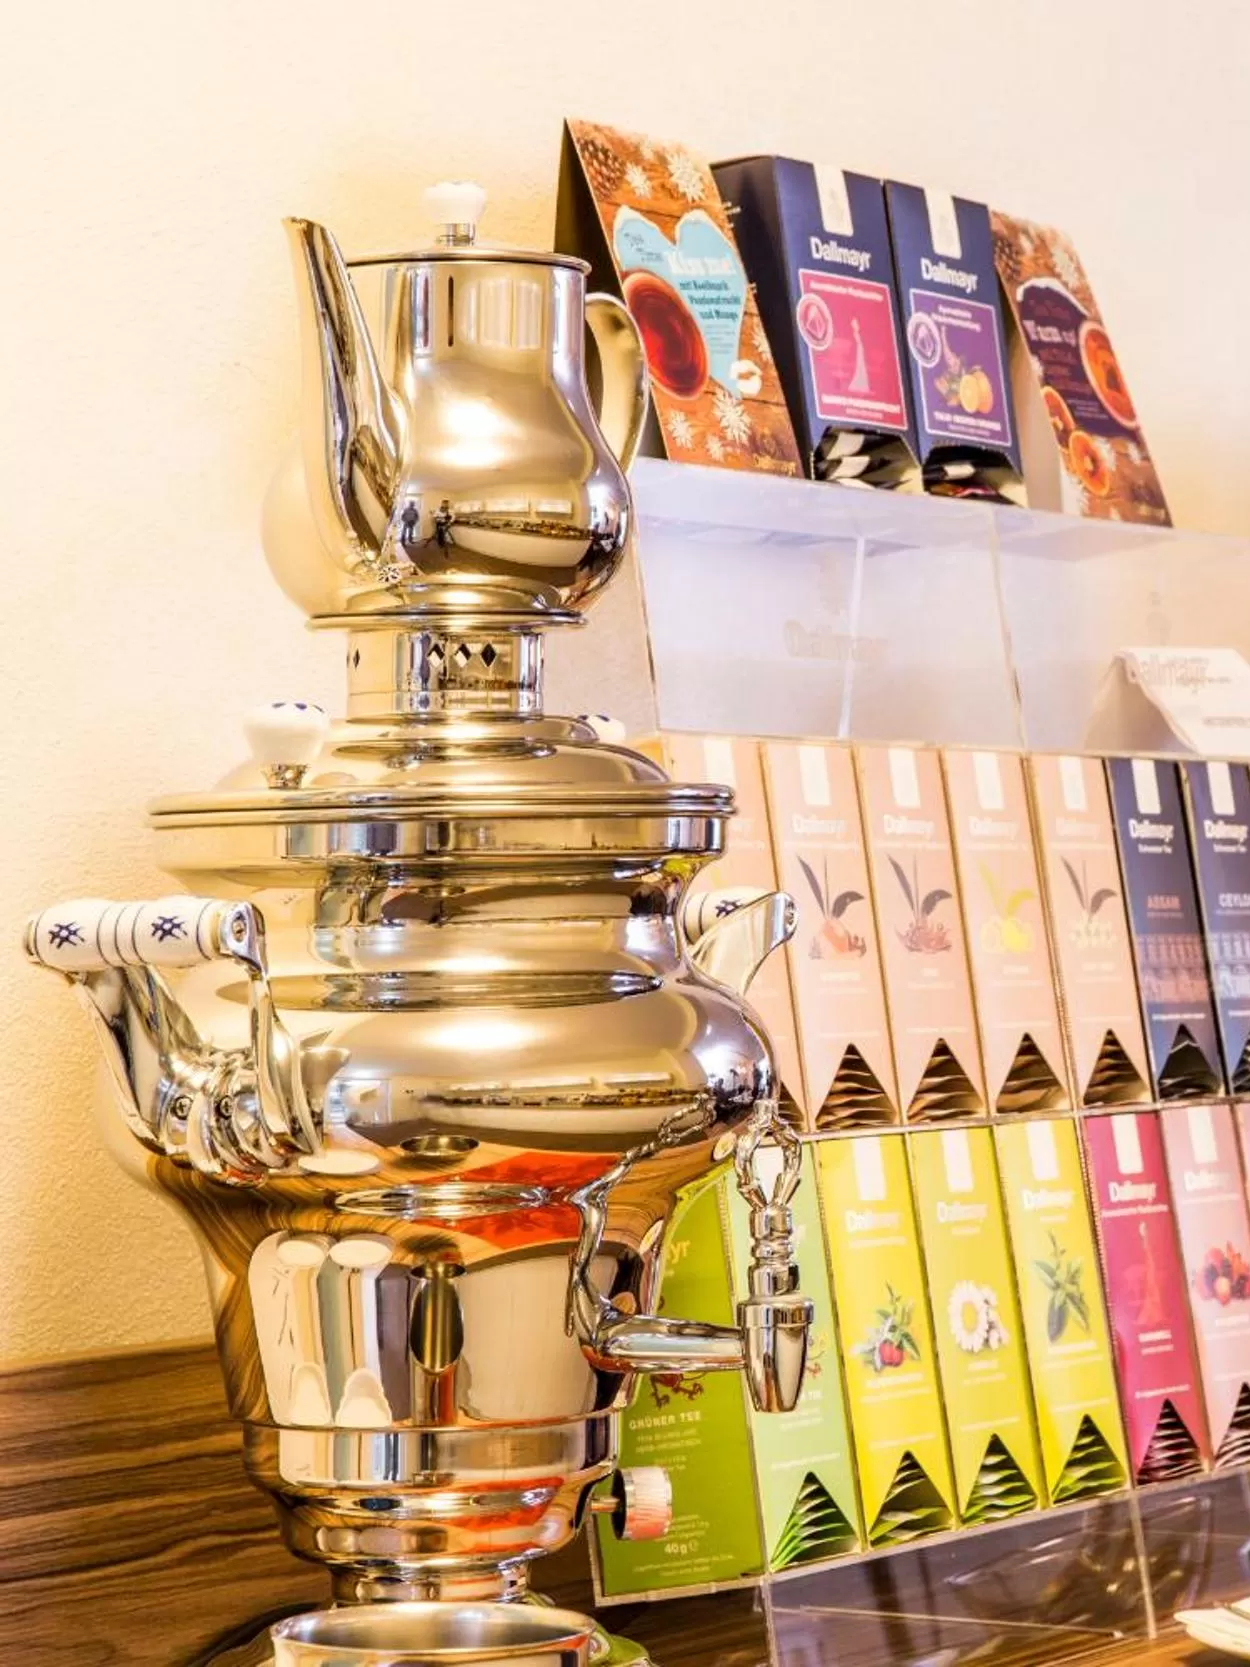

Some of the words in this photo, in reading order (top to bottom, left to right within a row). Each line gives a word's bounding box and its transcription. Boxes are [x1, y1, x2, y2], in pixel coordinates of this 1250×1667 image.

[809, 236, 871, 272] Dallmayr
[921, 257, 978, 293] Dallmayr
[628, 1413, 676, 1431] GRÜNER
[679, 1410, 702, 1424] TEE
